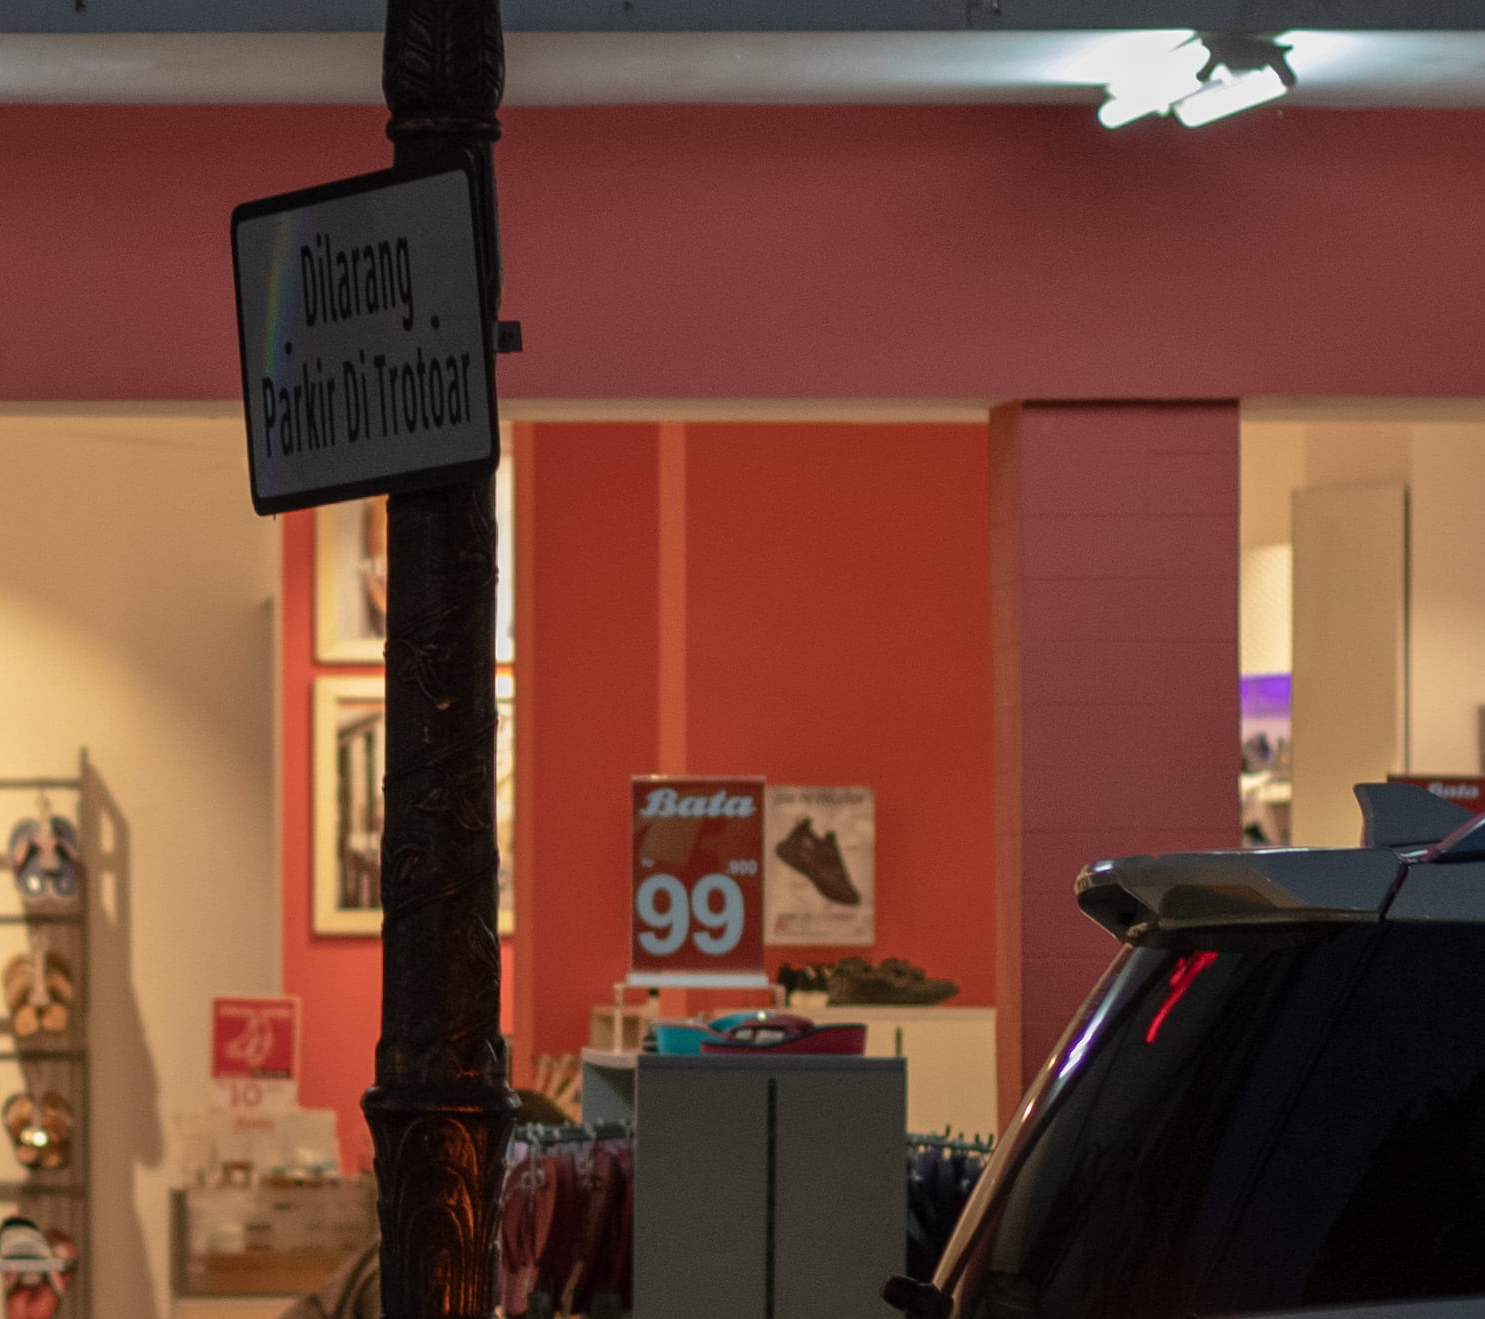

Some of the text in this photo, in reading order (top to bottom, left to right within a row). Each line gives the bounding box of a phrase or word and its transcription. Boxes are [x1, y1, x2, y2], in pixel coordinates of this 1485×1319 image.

[301, 233, 414, 331] Dilarang
[262, 348, 471, 458] Parkir Di Trotoar
[639, 787, 757, 818] Bata
[636, 872, 745, 956] 99
